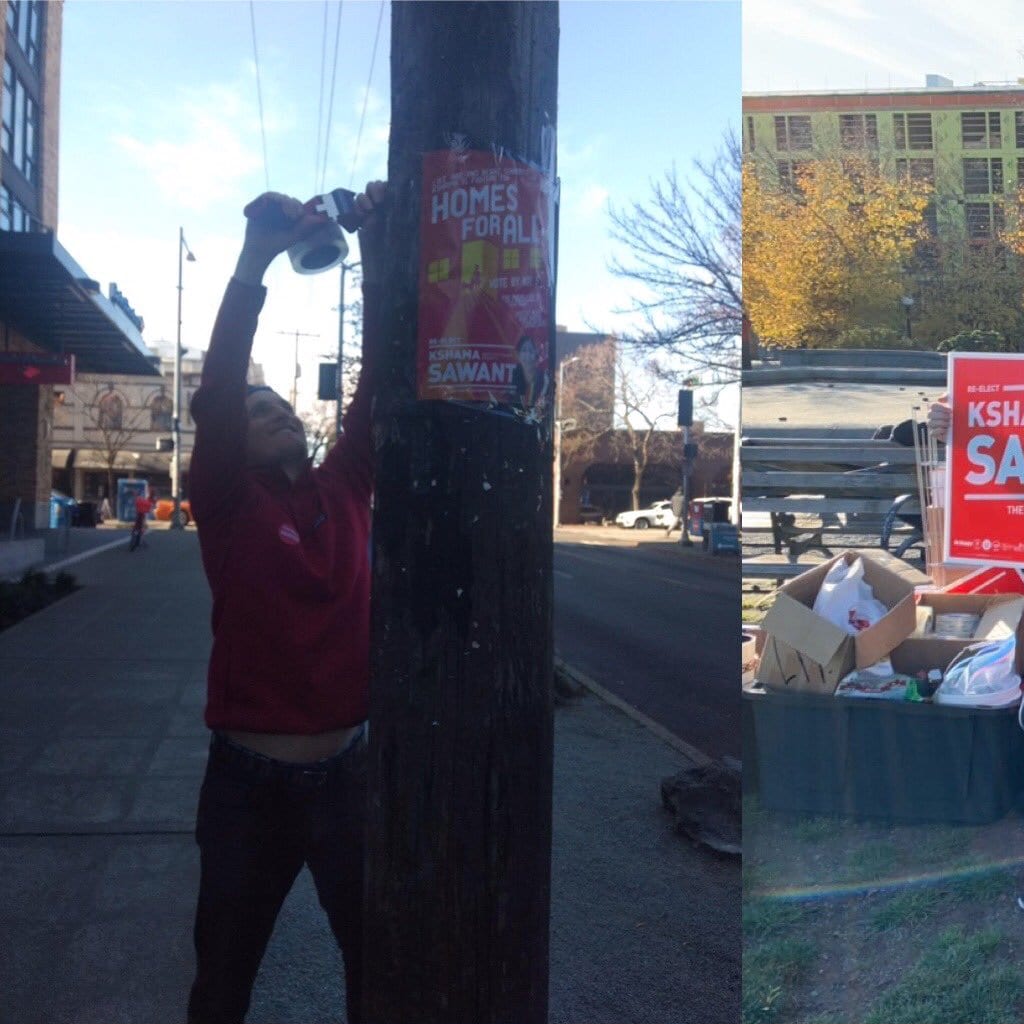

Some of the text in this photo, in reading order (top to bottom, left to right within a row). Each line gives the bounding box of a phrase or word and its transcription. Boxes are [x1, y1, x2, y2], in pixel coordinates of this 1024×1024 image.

[431, 184, 518, 224] HOMES
[462, 215, 500, 240] FOR
[429, 350, 480, 361] KSHAMA
[428, 362, 516, 383] SAWANT
[967, 385, 1000, 393] RE-ELECT
[1007, 506, 1023, 514] THE
